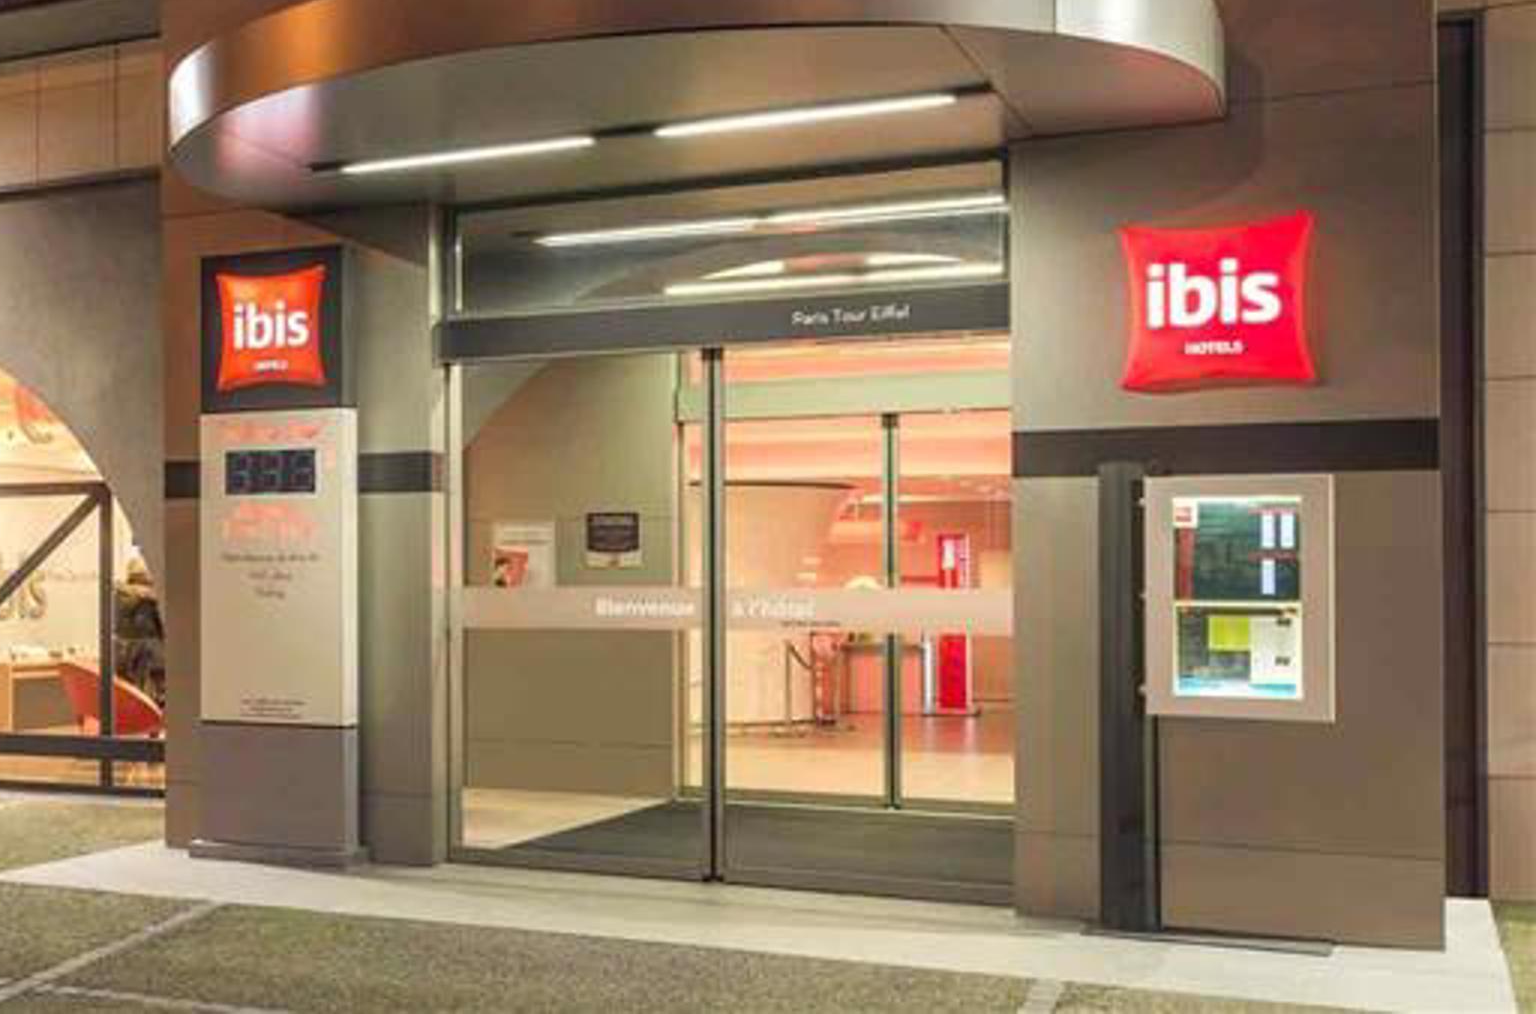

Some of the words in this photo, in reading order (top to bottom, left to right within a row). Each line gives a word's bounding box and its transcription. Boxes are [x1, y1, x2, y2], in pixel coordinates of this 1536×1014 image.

[1147, 257, 1282, 330] ibis
[233, 300, 309, 350] ibis
[791, 306, 829, 325] Paris
[832, 307, 866, 323] Tour
[869, 302, 910, 321] Eiffel
[596, 595, 695, 618] Bienvenue
